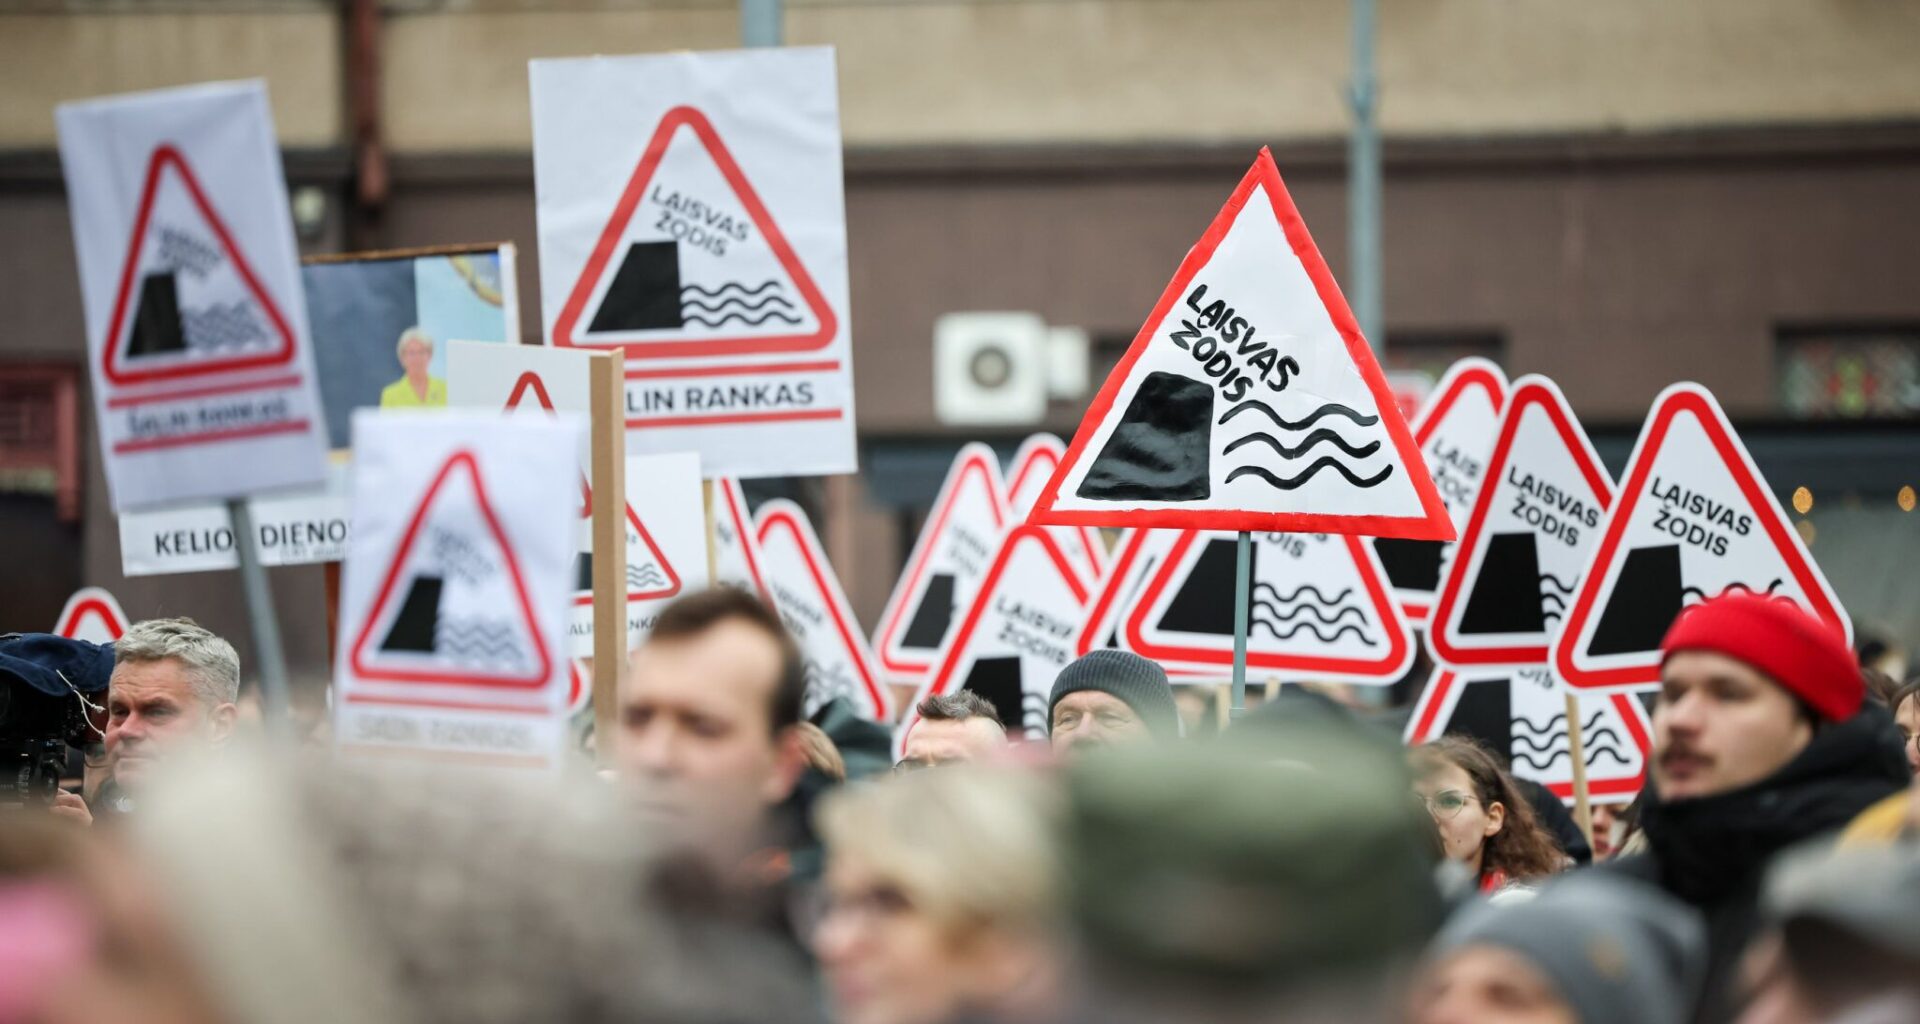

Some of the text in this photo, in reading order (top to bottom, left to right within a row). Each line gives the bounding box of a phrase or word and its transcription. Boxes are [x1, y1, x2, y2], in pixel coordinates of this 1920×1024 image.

[651, 184, 748, 242] LAISVAS
[1169, 316, 1254, 402] ŽODIS
[1186, 283, 1300, 392] LAISVAS
[626, 381, 815, 414] LIN RANKAS
[1432, 437, 1479, 480] LAIS
[1508, 466, 1600, 529] LAISVAS
[1511, 492, 1581, 547] ŽODIS
[1650, 476, 1753, 537] LAISVAS
[155, 519, 350, 555] KELIO DIENO
[1652, 499, 1730, 557] ŽODIS
